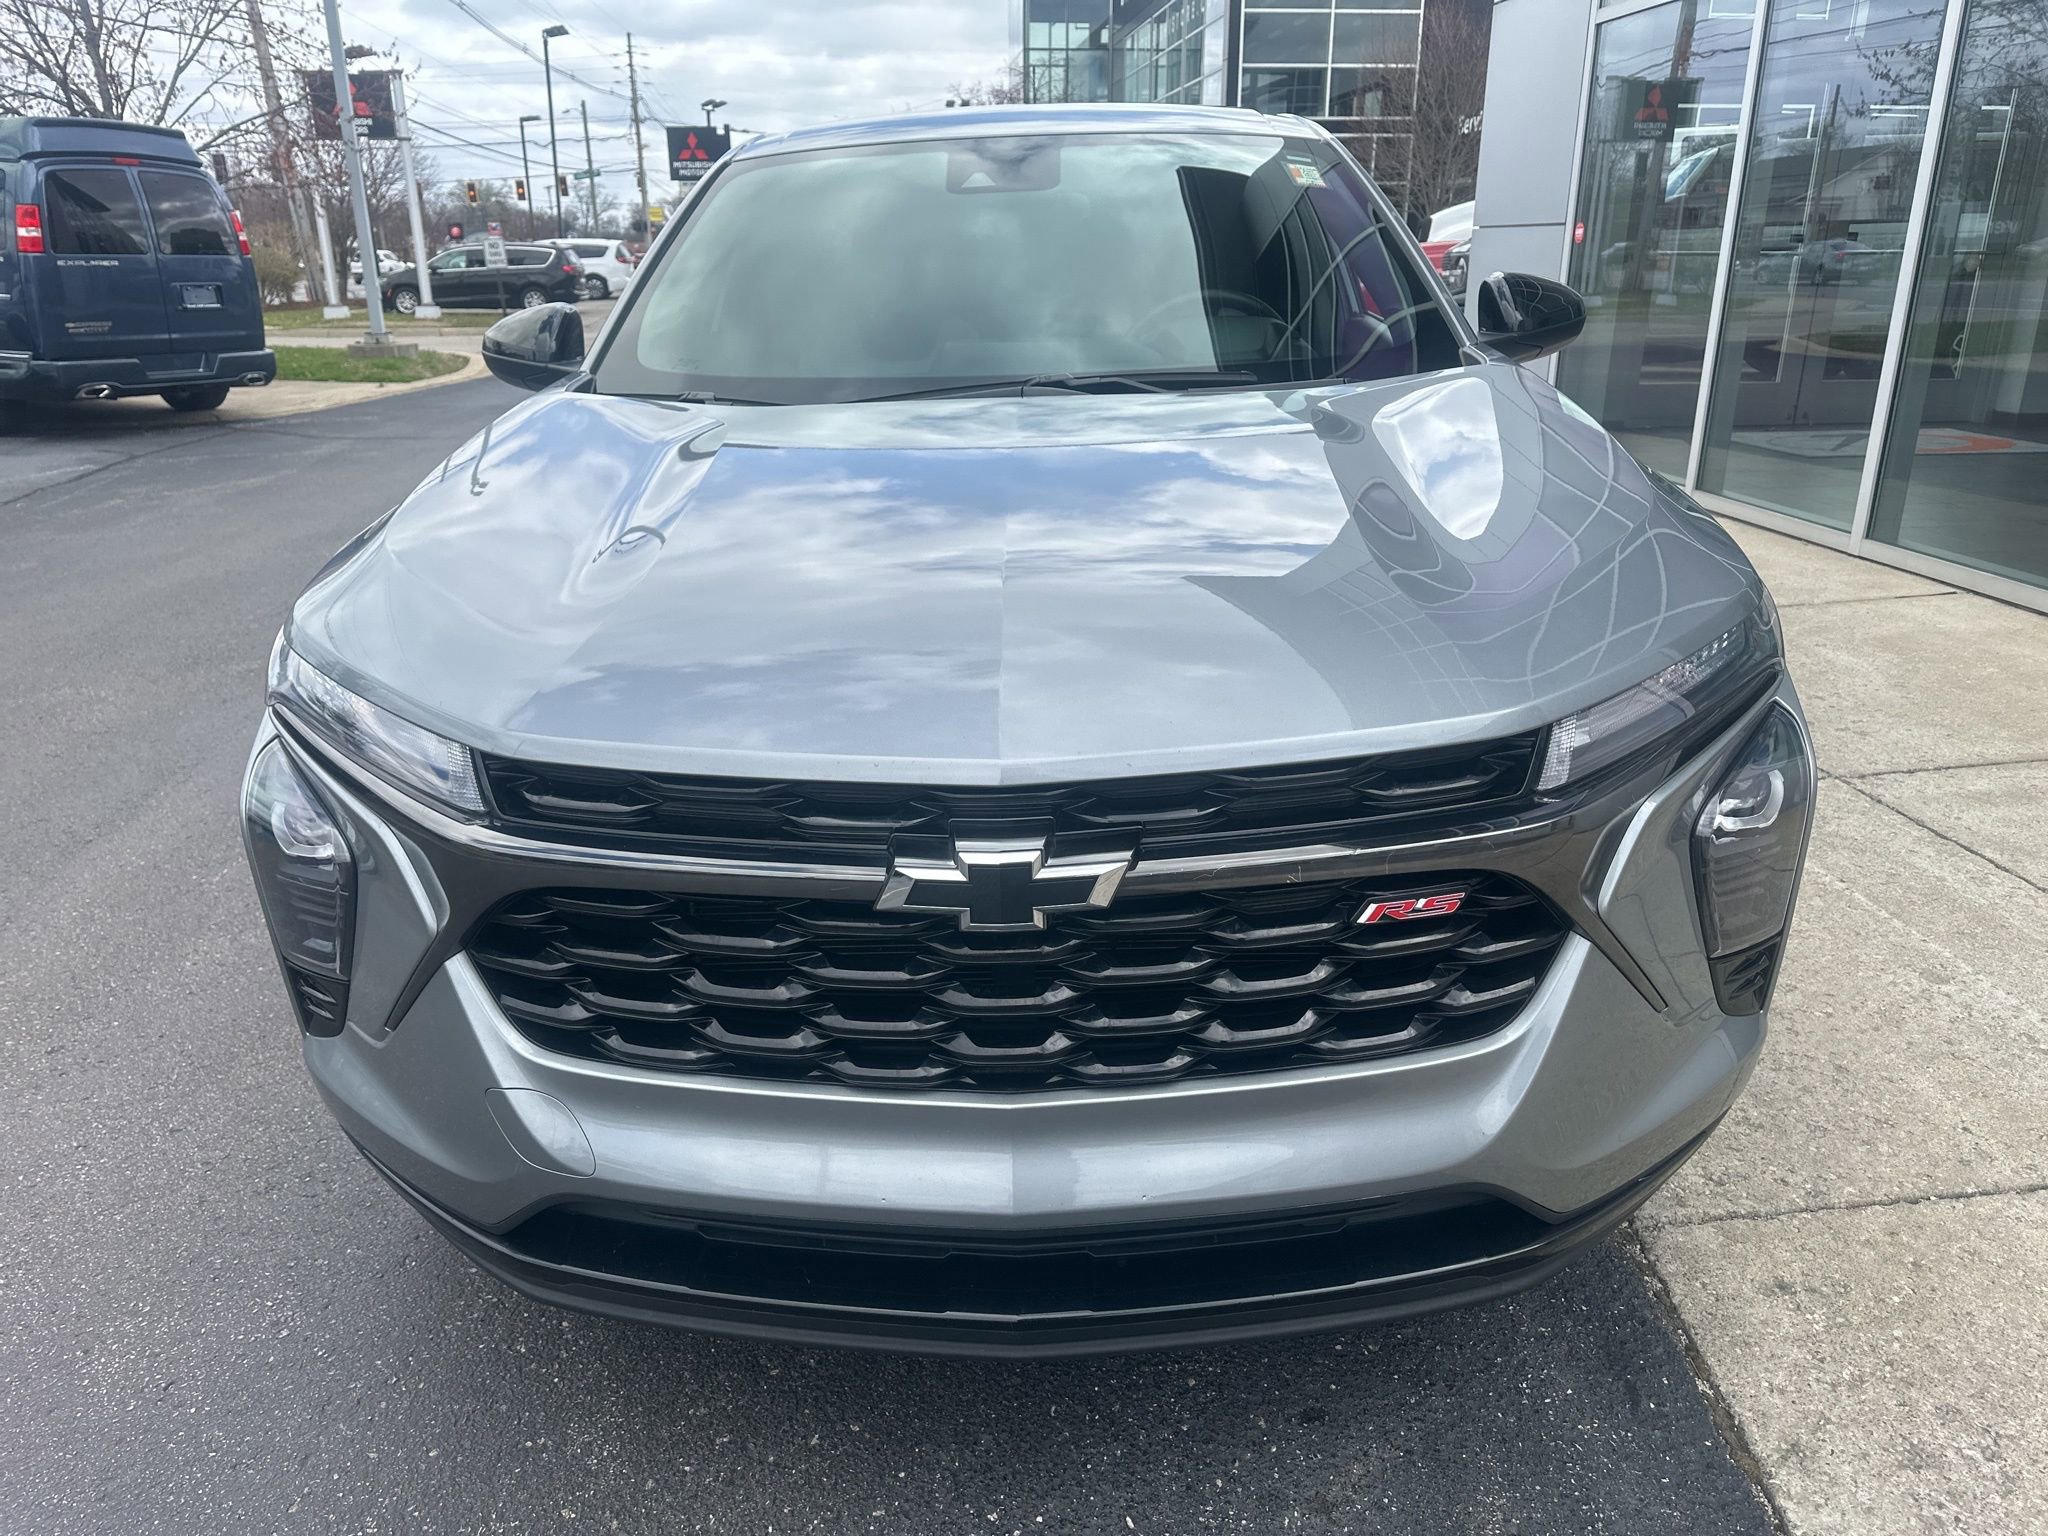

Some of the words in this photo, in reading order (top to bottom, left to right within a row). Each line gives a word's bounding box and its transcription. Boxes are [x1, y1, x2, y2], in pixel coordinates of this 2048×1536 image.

[1457, 110, 1483, 135] Servi
[672, 160, 714, 169] MITSUBISH
[1355, 891, 1467, 924] RS
